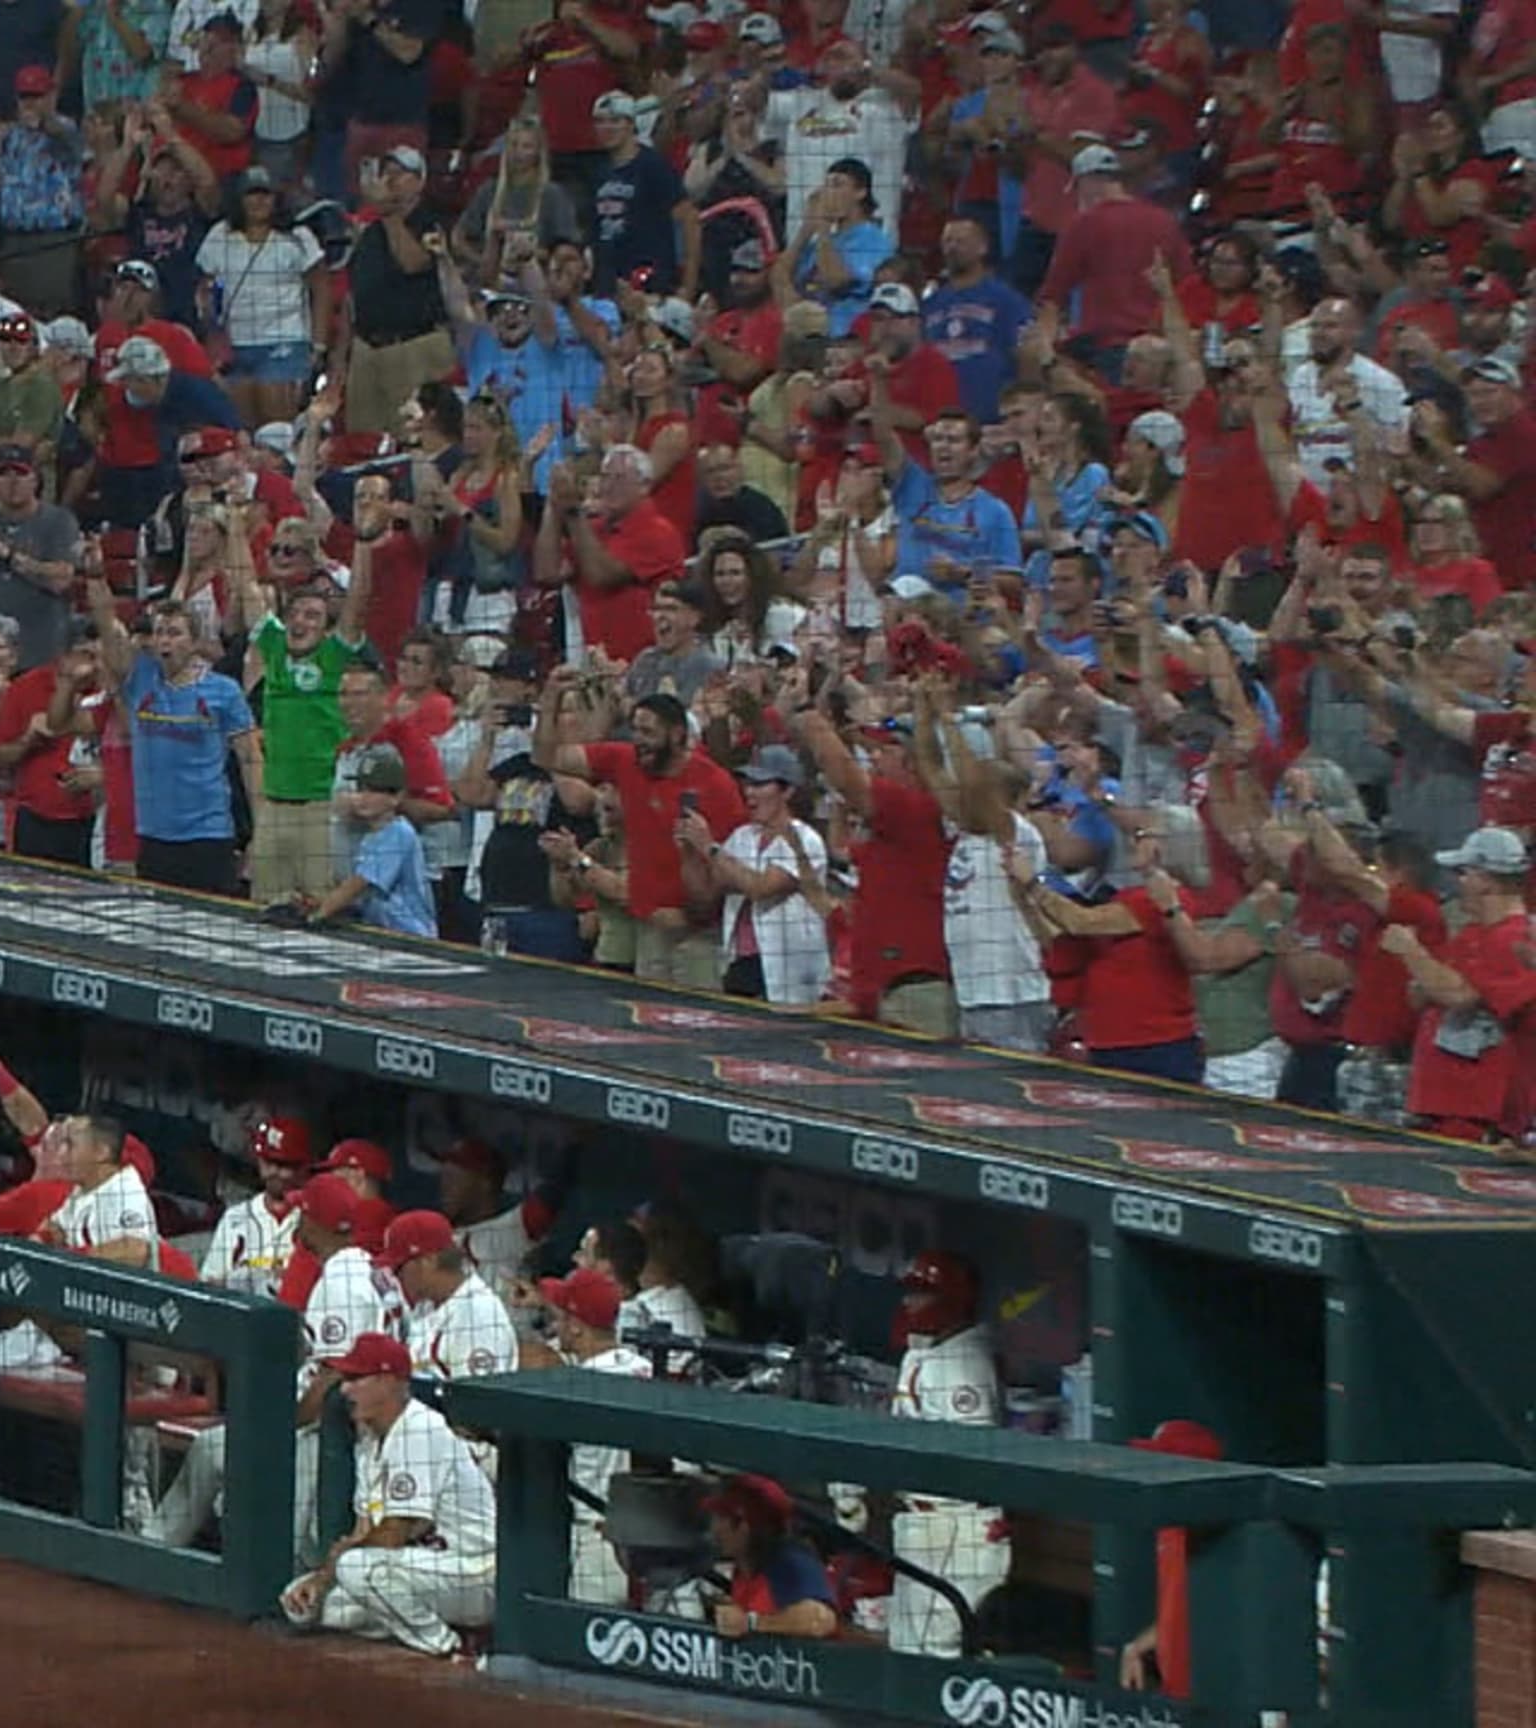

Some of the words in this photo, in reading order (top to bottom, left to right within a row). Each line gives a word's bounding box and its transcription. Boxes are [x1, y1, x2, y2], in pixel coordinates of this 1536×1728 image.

[53, 970, 107, 1008] GEICO
[158, 993, 212, 1032] GEICO
[265, 1017, 322, 1055] GEICO
[377, 1039, 434, 1078] GEICO
[491, 1063, 550, 1103] GEICO
[608, 1087, 668, 1129] GEICO
[728, 1113, 791, 1153] GEICO
[852, 1138, 917, 1180] GEICO
[980, 1164, 1048, 1209] GEICO
[1112, 1193, 1182, 1236] GEICO
[1249, 1221, 1322, 1267] GEICO
[64, 1285, 92, 1313] BANK
[96, 1293, 109, 1316] OF
[111, 1297, 158, 1329] AMERICA
